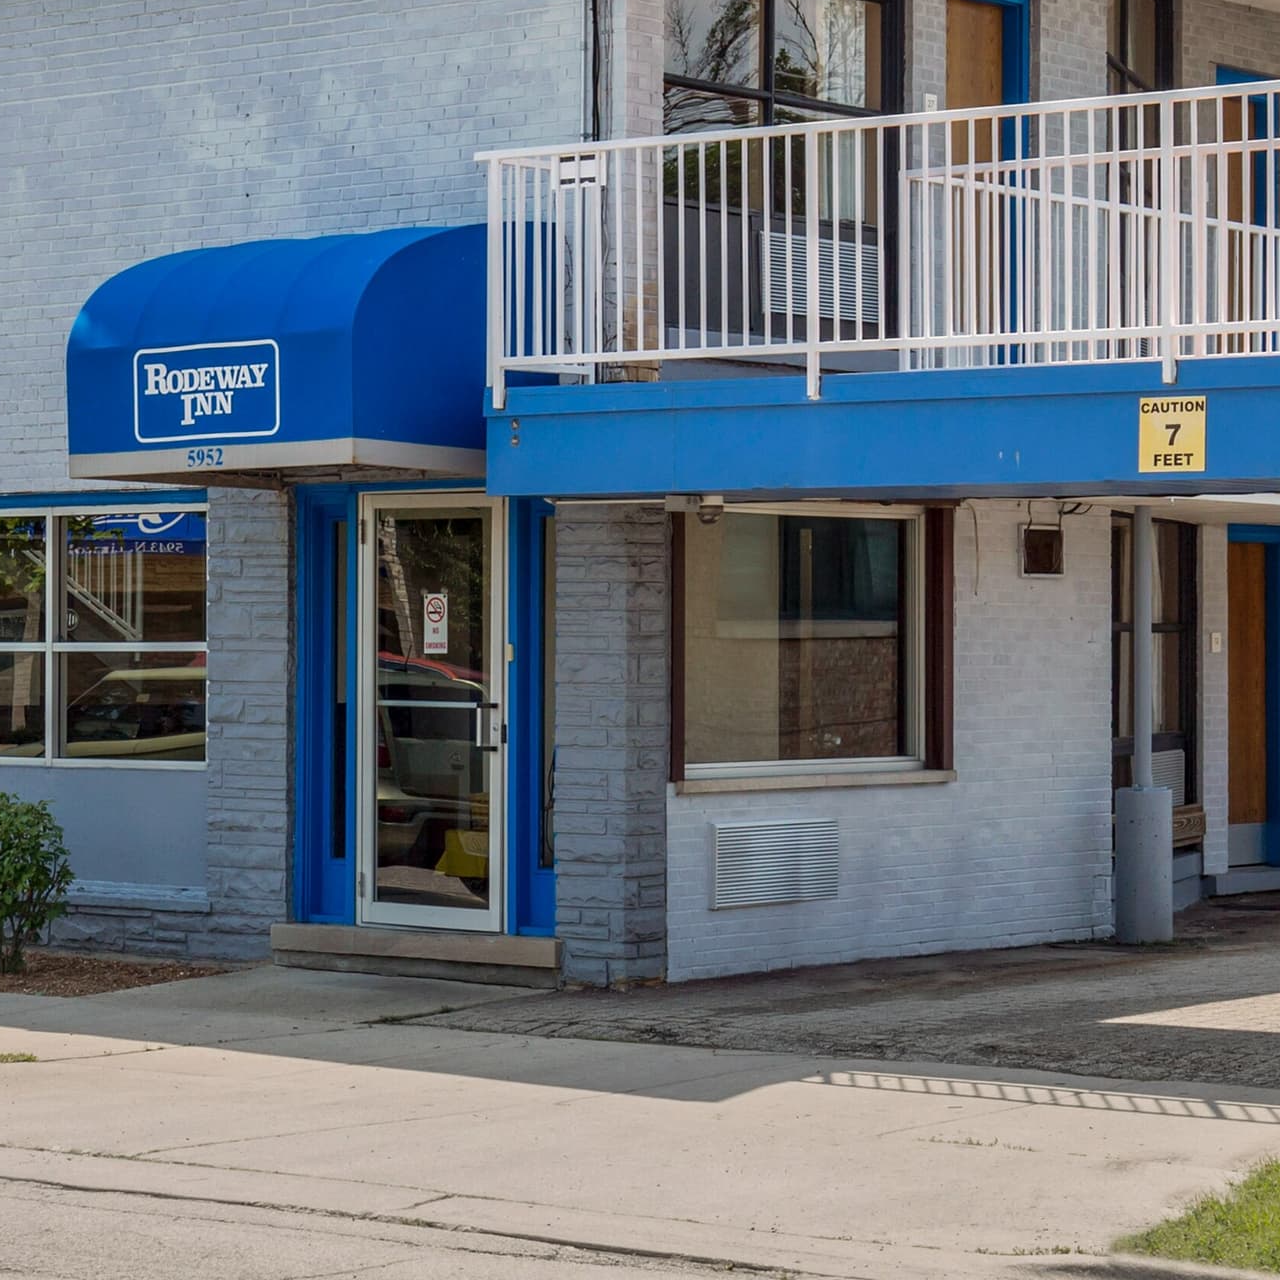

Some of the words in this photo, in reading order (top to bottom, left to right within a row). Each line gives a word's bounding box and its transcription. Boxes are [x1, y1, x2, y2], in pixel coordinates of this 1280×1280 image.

[143, 363, 269, 396] RODEWAY
[180, 391, 234, 426] INN
[1141, 400, 1205, 414] CAUTION
[1165, 423, 1181, 446] 7
[187, 448, 224, 468] 5952
[1153, 453, 1194, 467] FEET
